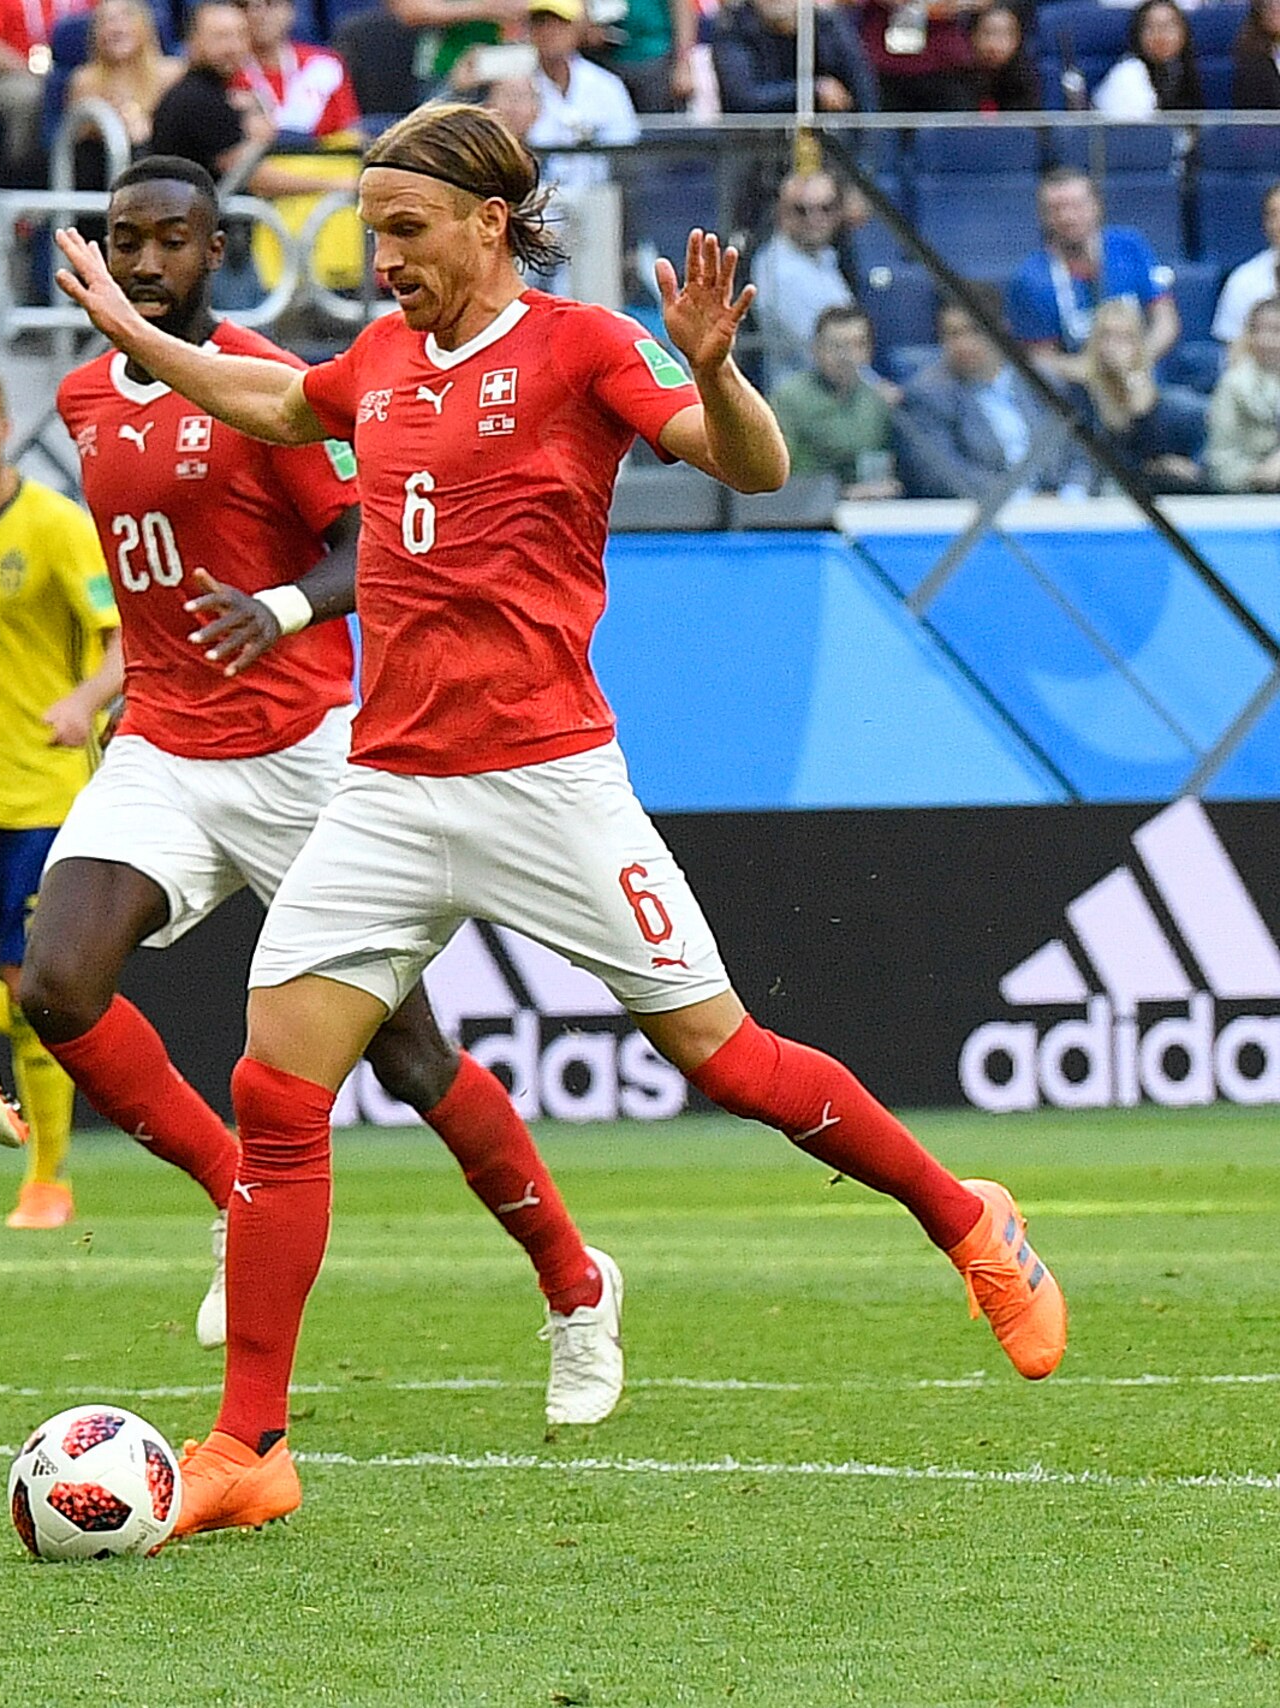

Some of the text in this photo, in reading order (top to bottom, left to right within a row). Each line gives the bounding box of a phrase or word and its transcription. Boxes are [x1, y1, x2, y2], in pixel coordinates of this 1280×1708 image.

[113, 511, 183, 592] 20
[402, 471, 435, 555] 6
[619, 863, 674, 945] 6
[330, 1008, 687, 1127] das
